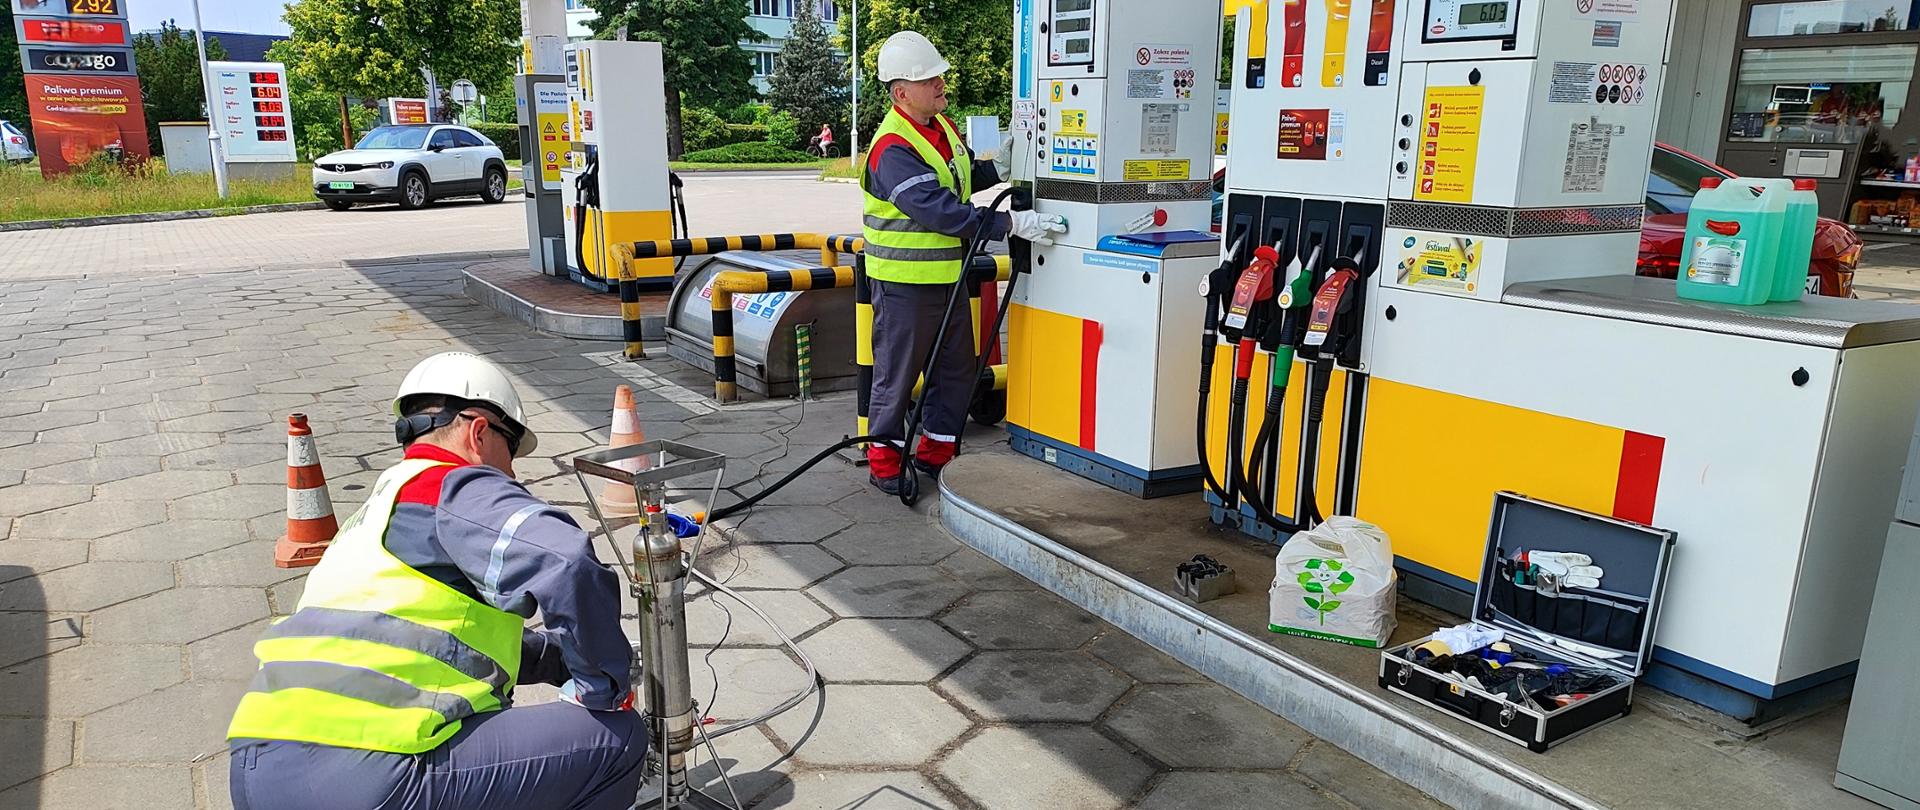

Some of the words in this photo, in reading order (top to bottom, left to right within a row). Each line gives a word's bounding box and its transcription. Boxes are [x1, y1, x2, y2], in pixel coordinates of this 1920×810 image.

[73, 0, 113, 13] 2.92
[1480, 3, 1506, 22] 6.03
[44, 85, 78, 94] Paliwa
[80, 86, 122, 96] premium
[258, 87, 280, 98] 6.04
[1055, 84, 1061, 99] 9
[260, 102, 282, 112] 6.03
